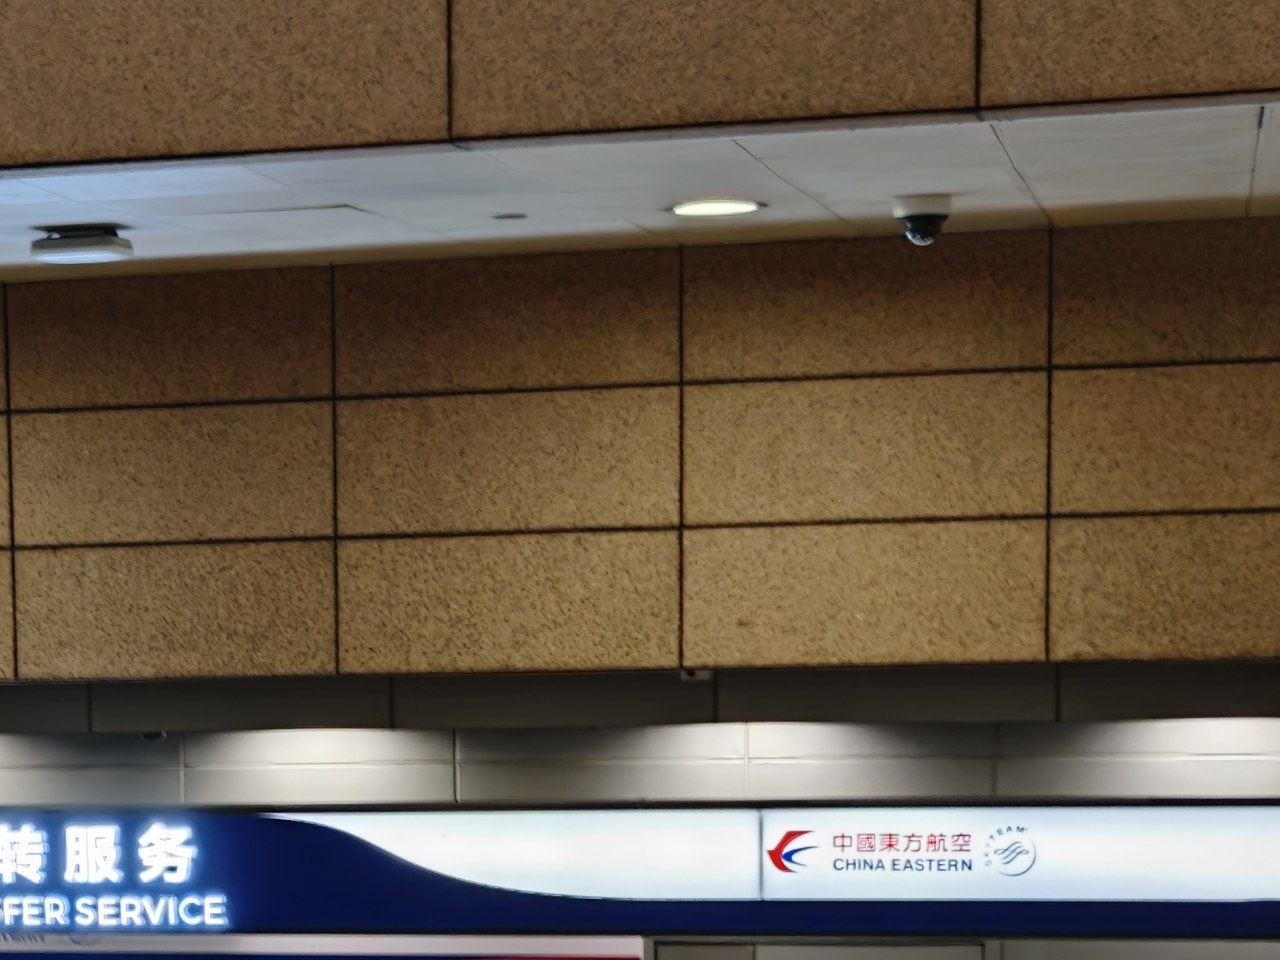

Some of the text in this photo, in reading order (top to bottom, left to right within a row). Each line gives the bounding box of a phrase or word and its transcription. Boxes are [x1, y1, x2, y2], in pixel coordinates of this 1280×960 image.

[832, 832, 972, 854] 中國東方航空
[832, 857, 973, 872] CHINA EASTERN
[74, 894, 229, 927] SERVICE
